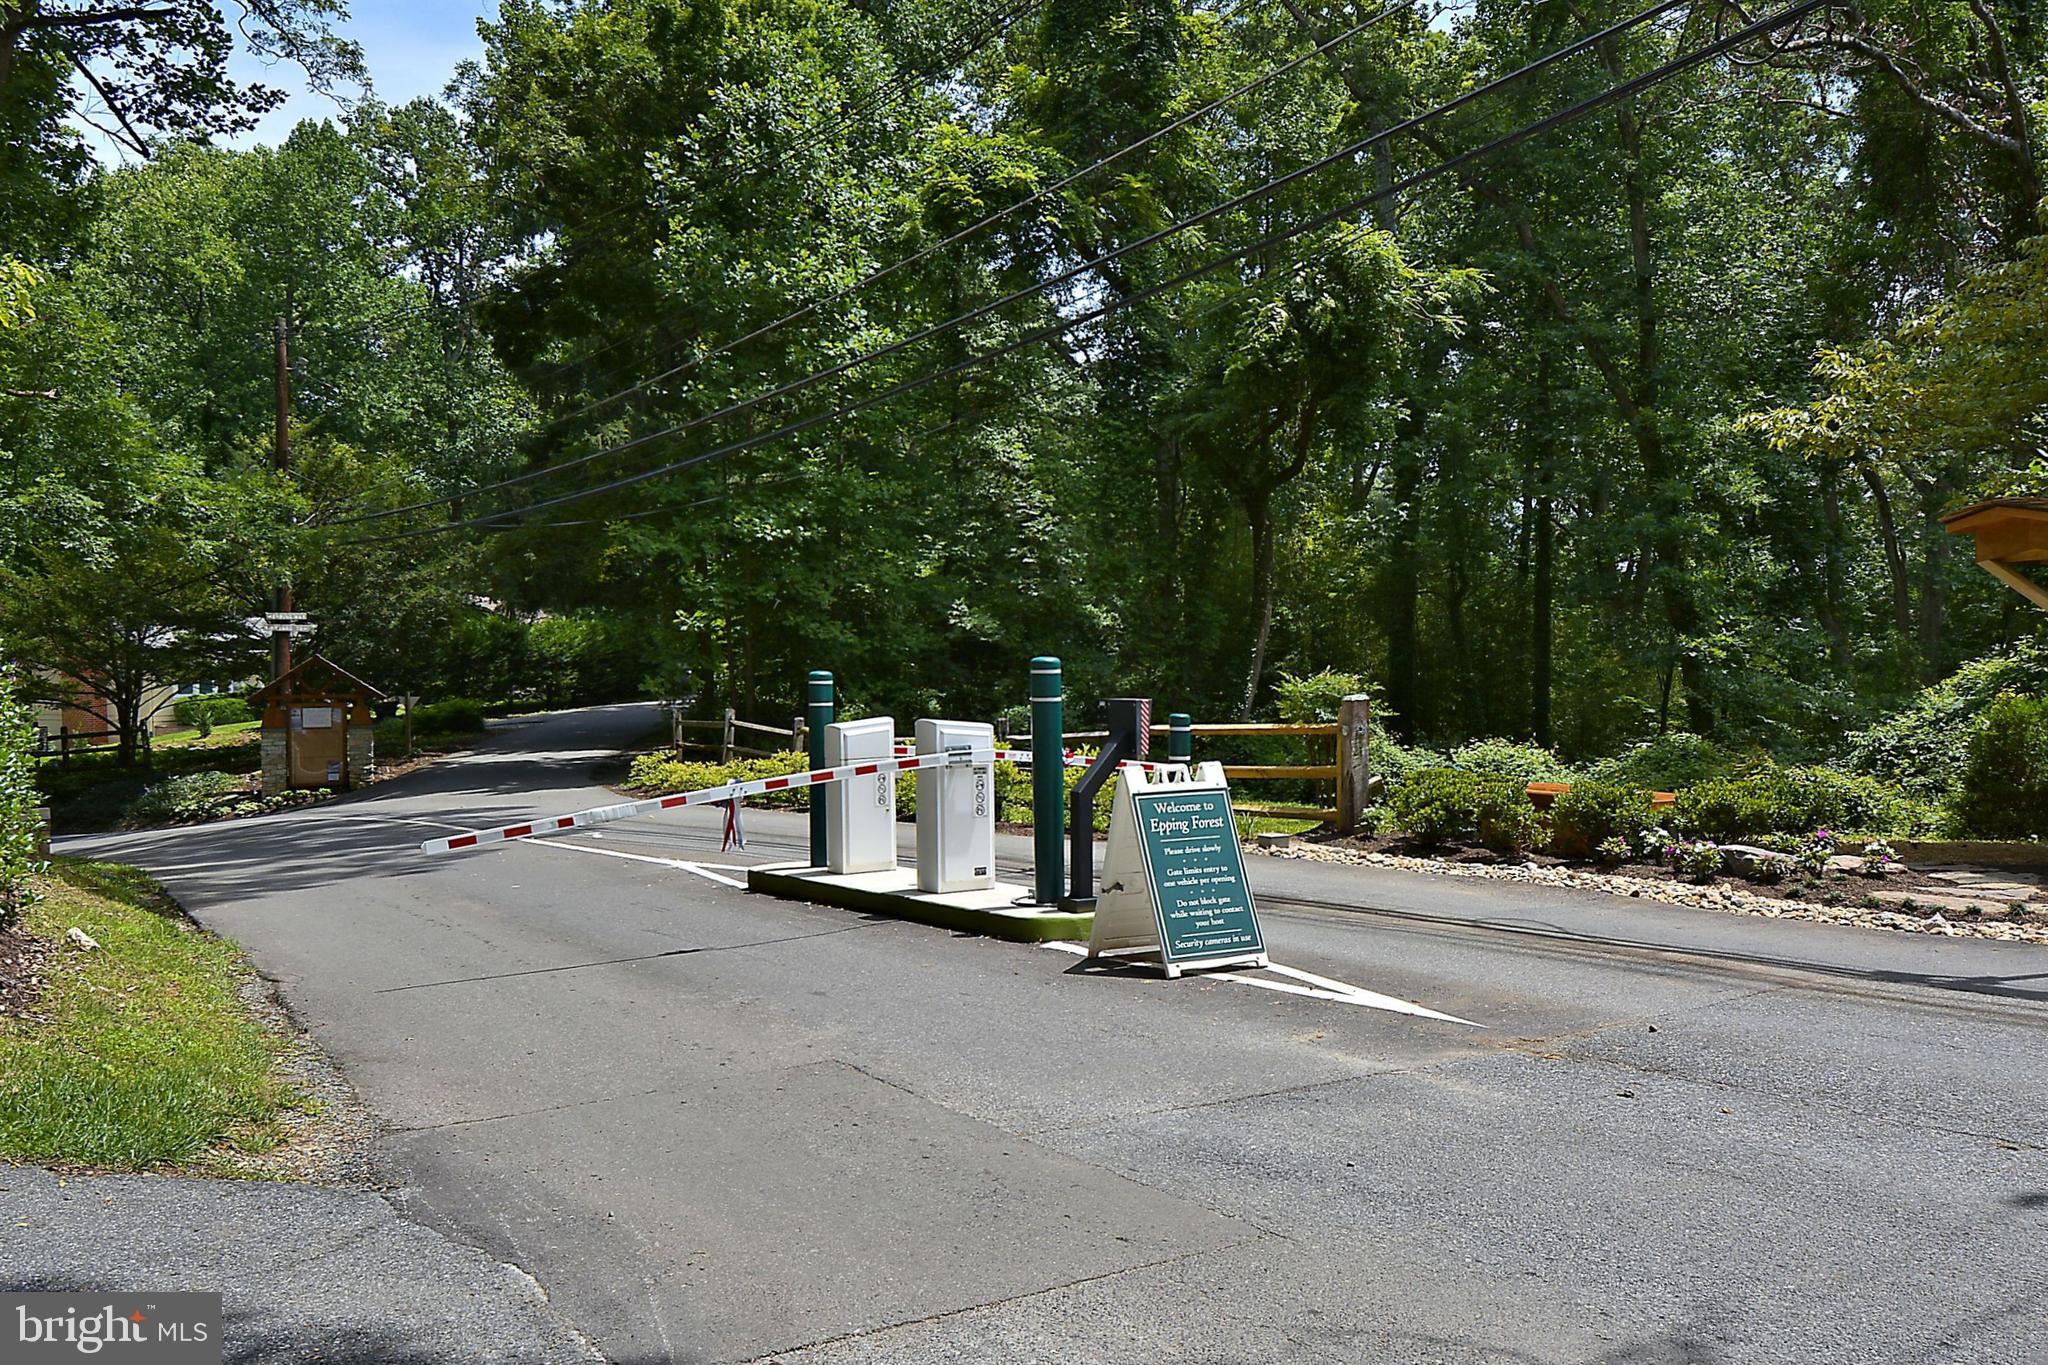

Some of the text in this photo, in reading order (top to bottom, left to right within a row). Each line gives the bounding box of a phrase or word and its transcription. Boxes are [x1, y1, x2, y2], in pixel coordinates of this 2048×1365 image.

[1153, 801, 1214, 814] Welcome to
[1150, 815, 1224, 836] Epping Forest
[1164, 844, 1221, 855] Please drive slowly
[1167, 868, 1183, 876] Gate
[1183, 866, 1202, 875] limits
[1203, 866, 1220, 874] entry
[1177, 877, 1199, 886] vehicle
[1199, 878, 1210, 886] per
[1211, 875, 1236, 885] opening
[1176, 899, 1188, 908] Do
[1200, 896, 1217, 905] block
[1218, 897, 1231, 905] gate
[1170, 910, 1188, 919] while
[1189, 908, 1214, 917] waiting
[1221, 906, 1244, 914] contact
[1195, 920, 1210, 929] your
[1175, 938, 1204, 949] Security
[1205, 936, 1231, 945] cameras
[1232, 934, 1240, 942] in
